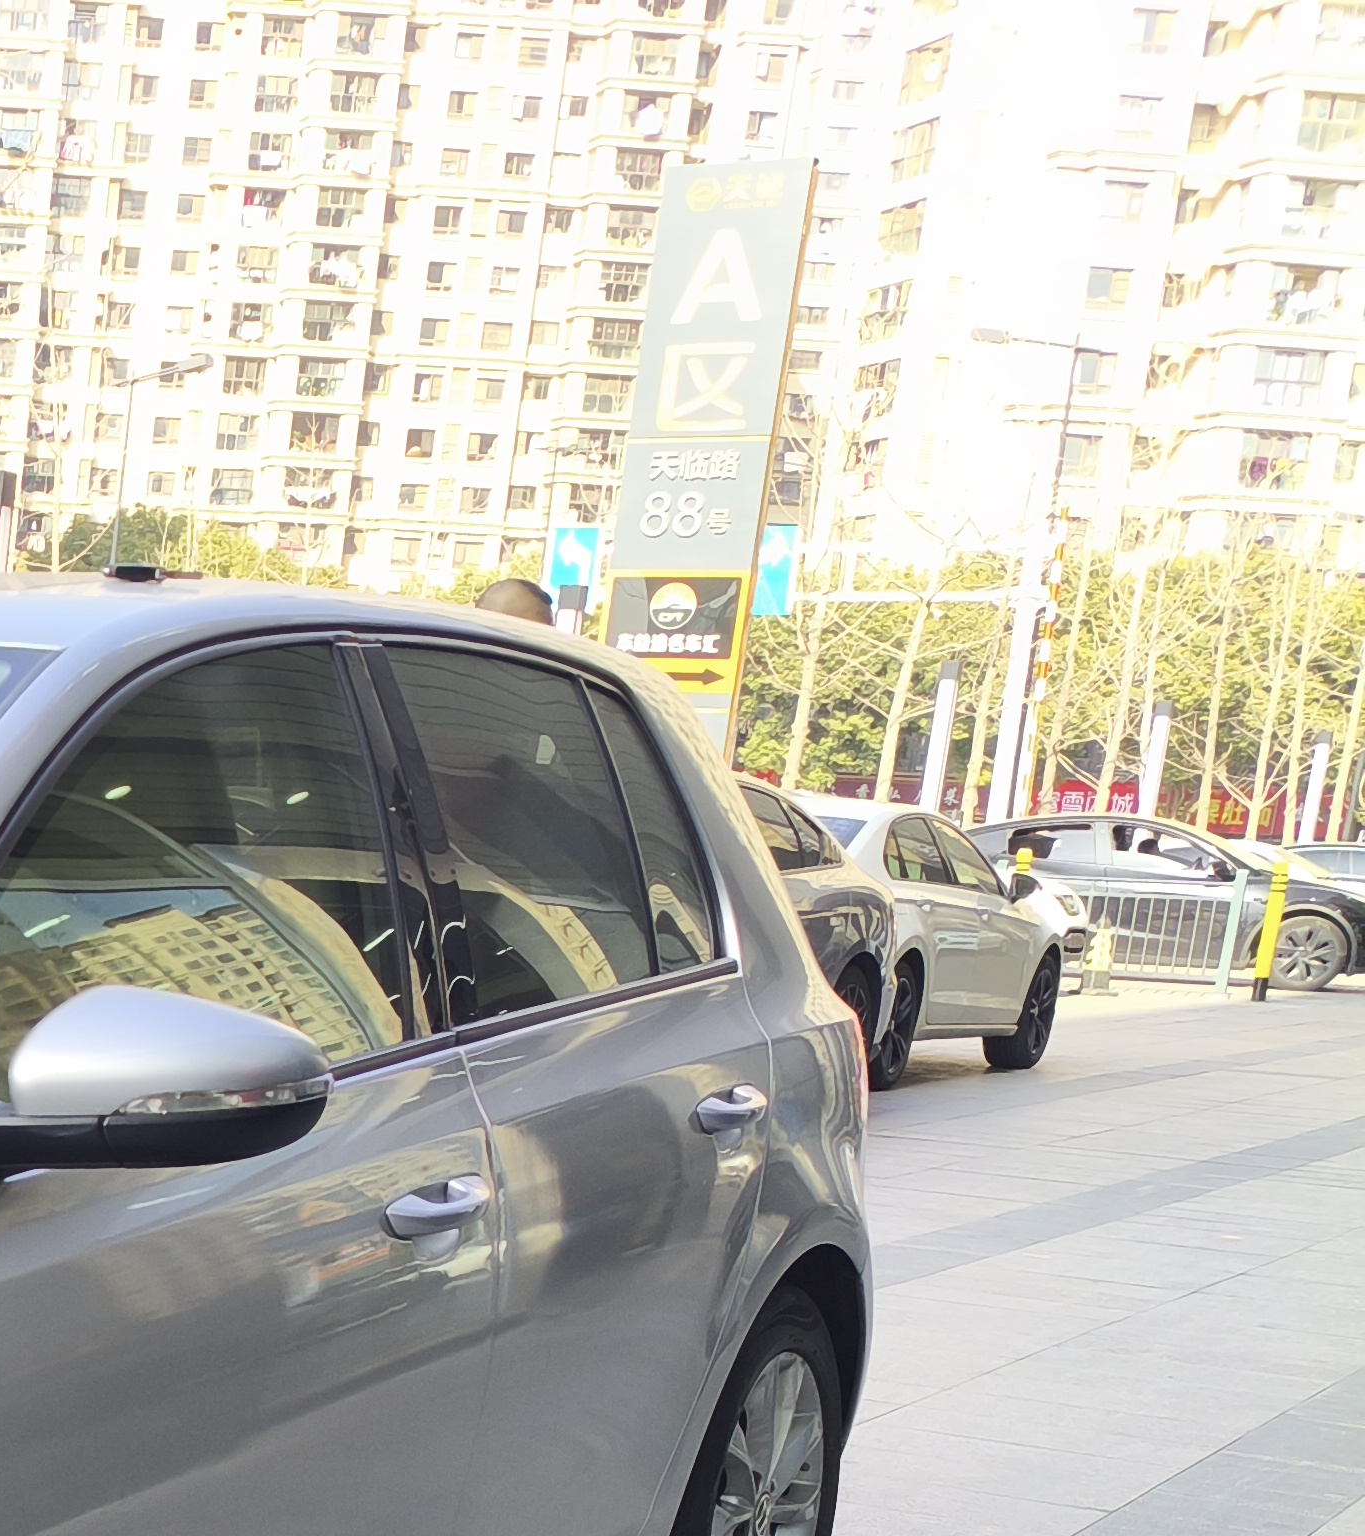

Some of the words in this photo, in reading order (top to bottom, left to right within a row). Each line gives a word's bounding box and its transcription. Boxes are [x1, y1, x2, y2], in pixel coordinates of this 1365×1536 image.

[648, 448, 741, 483] 天临路
[639, 490, 733, 539] 88号
